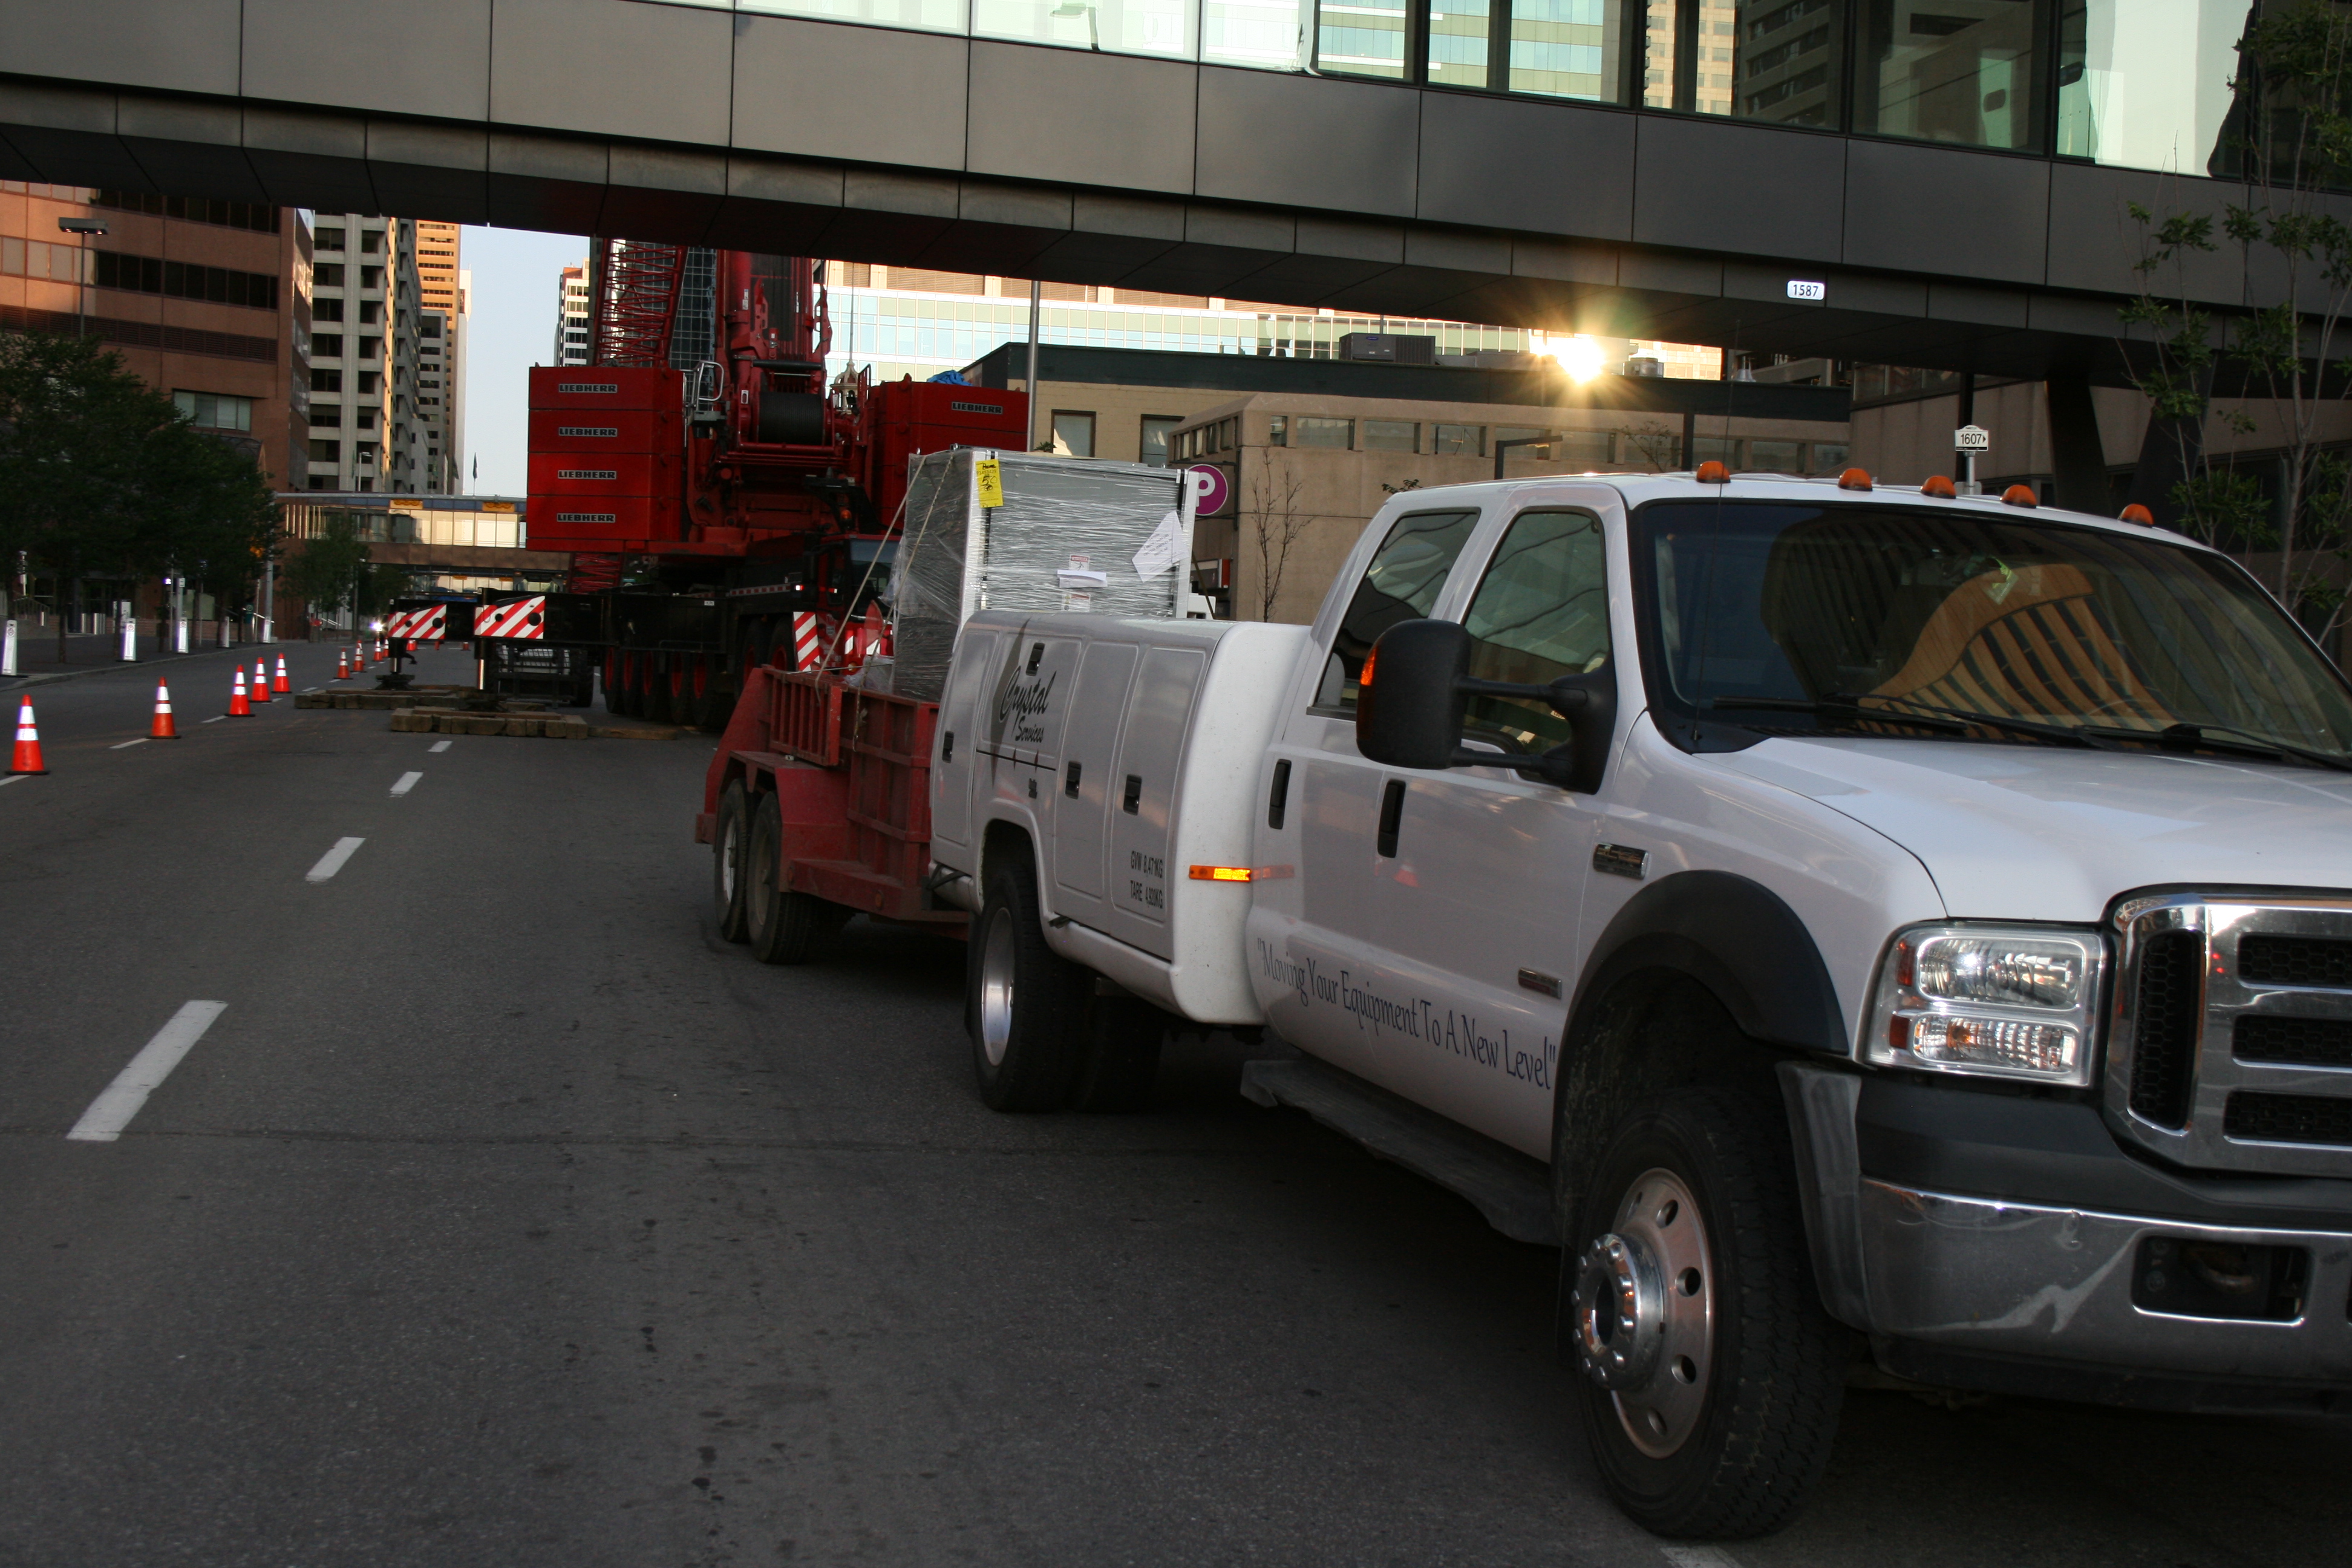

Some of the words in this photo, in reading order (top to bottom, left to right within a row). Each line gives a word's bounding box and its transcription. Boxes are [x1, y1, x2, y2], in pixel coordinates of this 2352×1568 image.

[1793, 284, 1818, 297] 1587
[952, 402, 1002, 413] LIEBHERR
[1961, 433, 1982, 445] 1607
[1196, 472, 1215, 507] P
[999, 665, 1057, 737] Crystal
[1015, 715, 1044, 743] Services
[1130, 880, 1143, 902] TARE
[1306, 957, 1338, 1004] Your
[1340, 970, 1419, 1038] Equipment
[1420, 999, 1440, 1047] To
[1446, 1010, 1460, 1054] A
[1461, 1014, 1498, 1068] New
